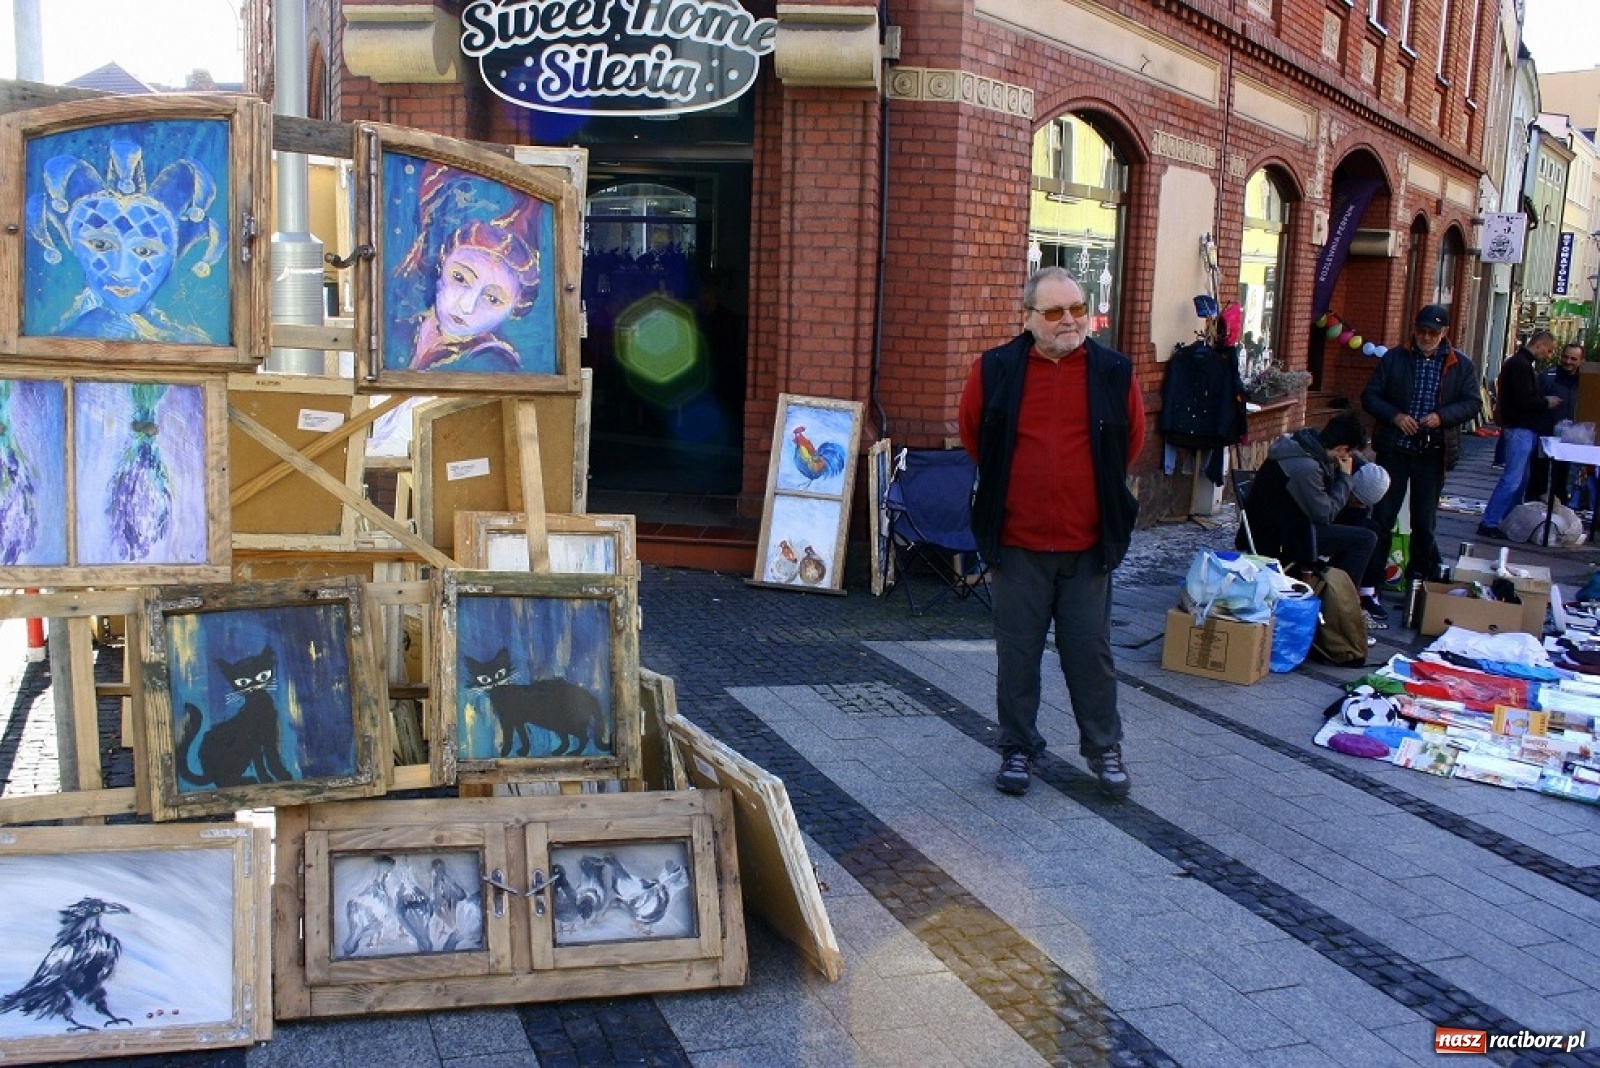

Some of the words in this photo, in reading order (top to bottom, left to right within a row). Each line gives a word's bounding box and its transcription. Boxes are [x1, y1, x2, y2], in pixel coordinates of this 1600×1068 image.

[462, 0, 610, 55] Sweet
[627, 0, 777, 54] Home
[539, 45, 701, 100] Silesia
[1557, 234, 1571, 293] STOMATOLOG
